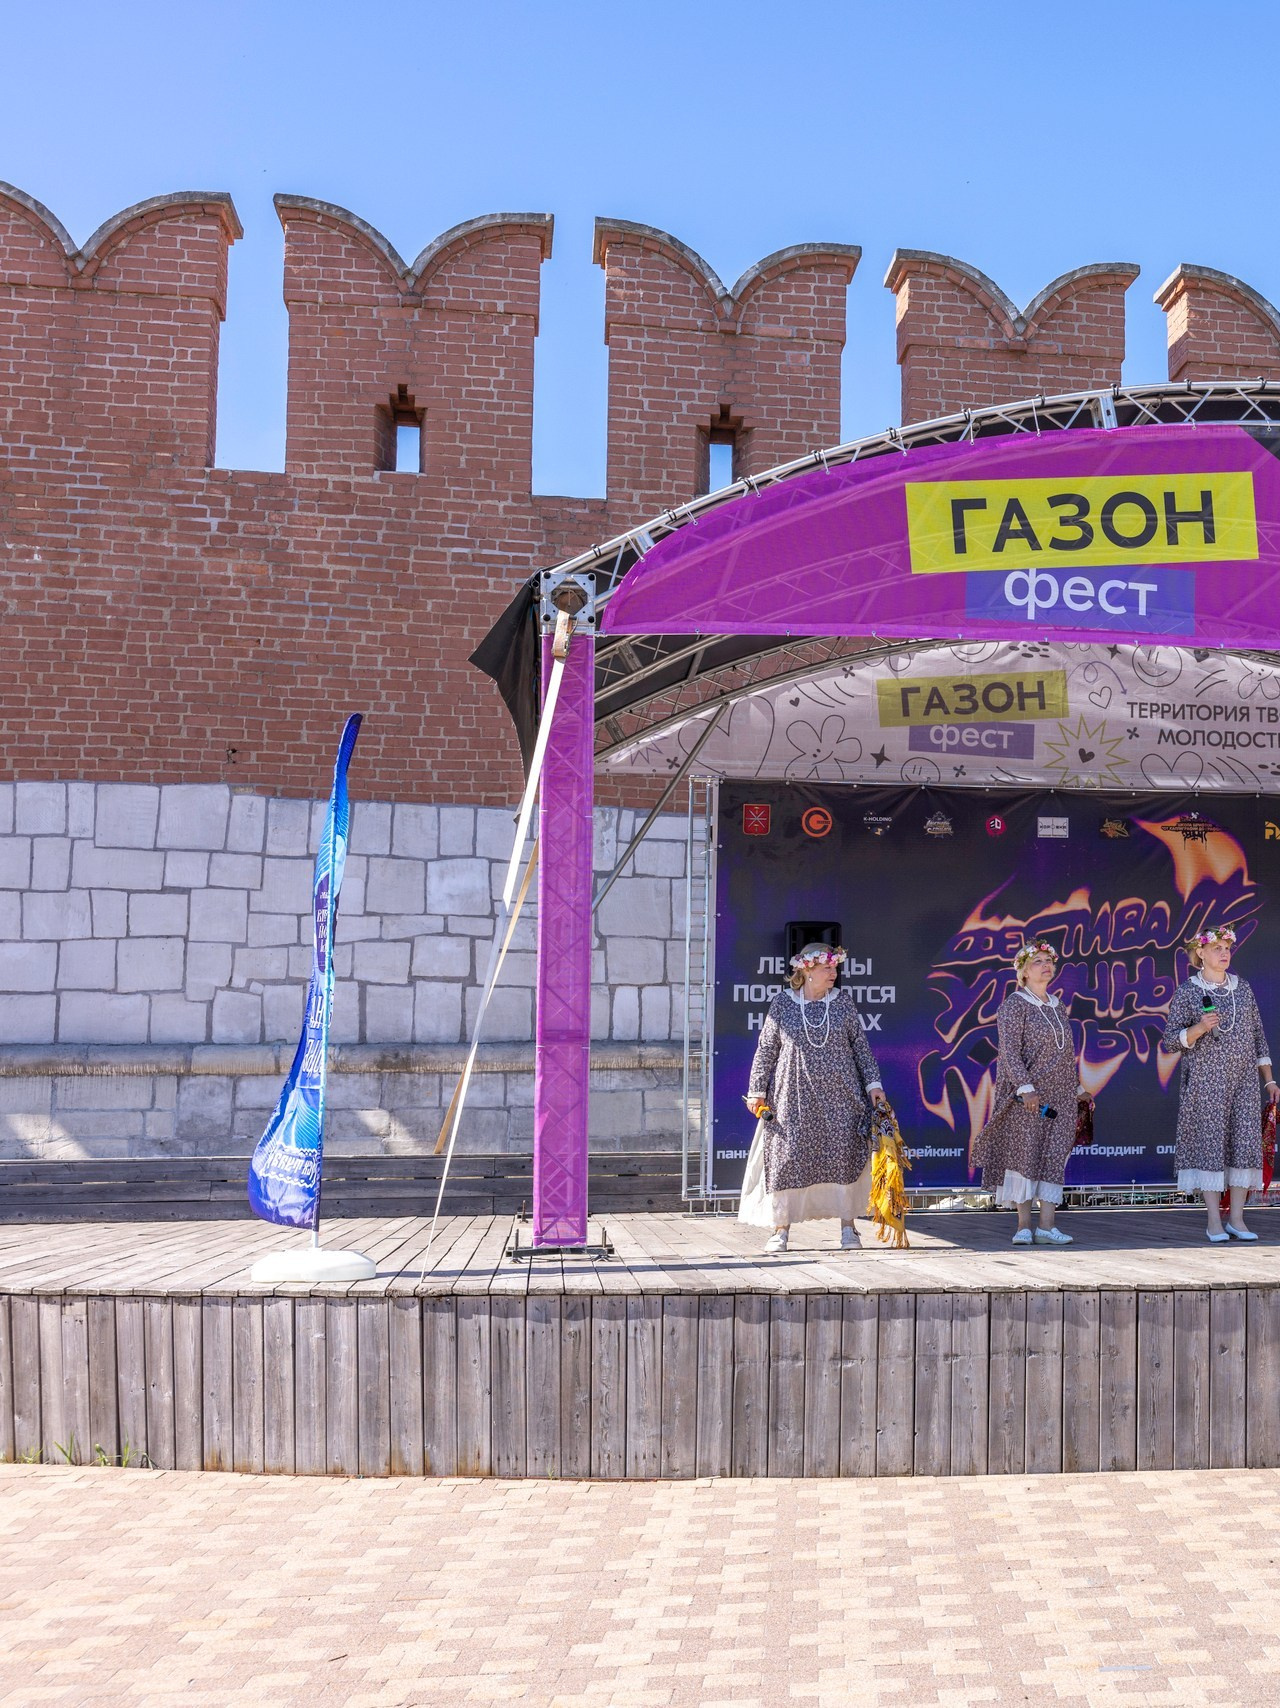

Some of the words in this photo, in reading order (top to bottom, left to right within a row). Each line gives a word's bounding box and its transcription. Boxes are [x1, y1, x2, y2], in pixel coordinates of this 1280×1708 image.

[950, 489, 1218, 555] ГАЗОН
[1003, 567, 1159, 620] фест
[899, 680, 1047, 717] ГАЗОН
[1126, 701, 1250, 722] ТЕРРИТОРИЯ
[928, 721, 1015, 754] фест
